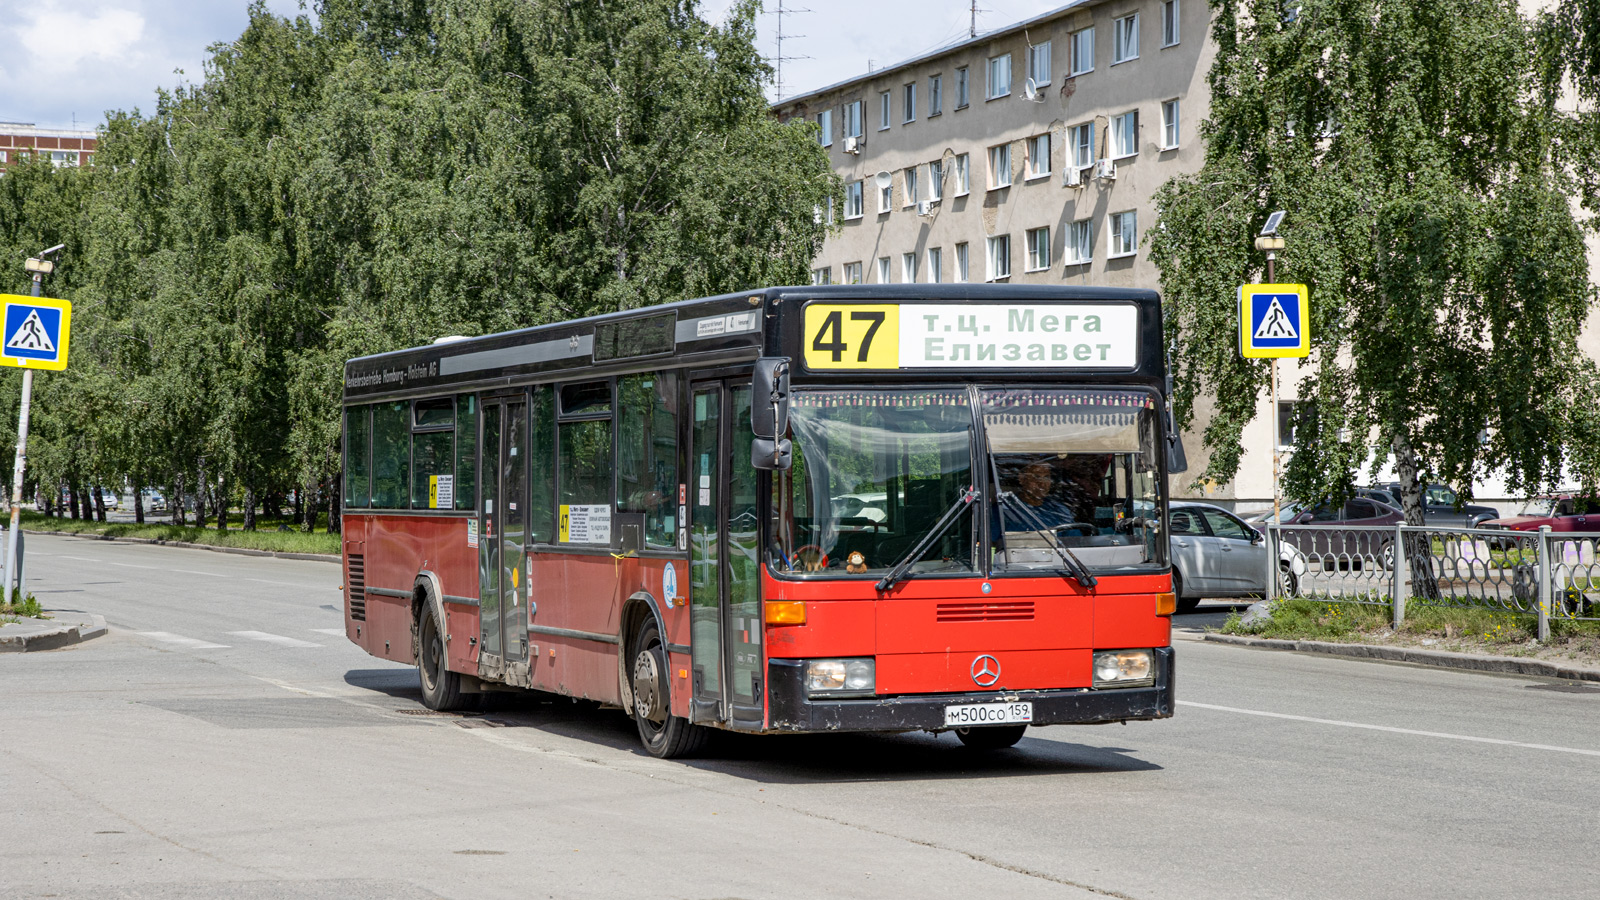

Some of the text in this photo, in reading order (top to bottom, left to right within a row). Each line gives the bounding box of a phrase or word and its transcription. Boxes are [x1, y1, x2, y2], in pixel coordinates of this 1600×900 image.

[1007, 309, 1102, 332] Мега
[812, 311, 886, 362] 47
[924, 337, 1112, 361] Елизавет
[429, 361, 437, 376] AG
[430, 484, 436, 499] 47
[560, 514, 568, 533] 47
[1008, 704, 1029, 716] 159
